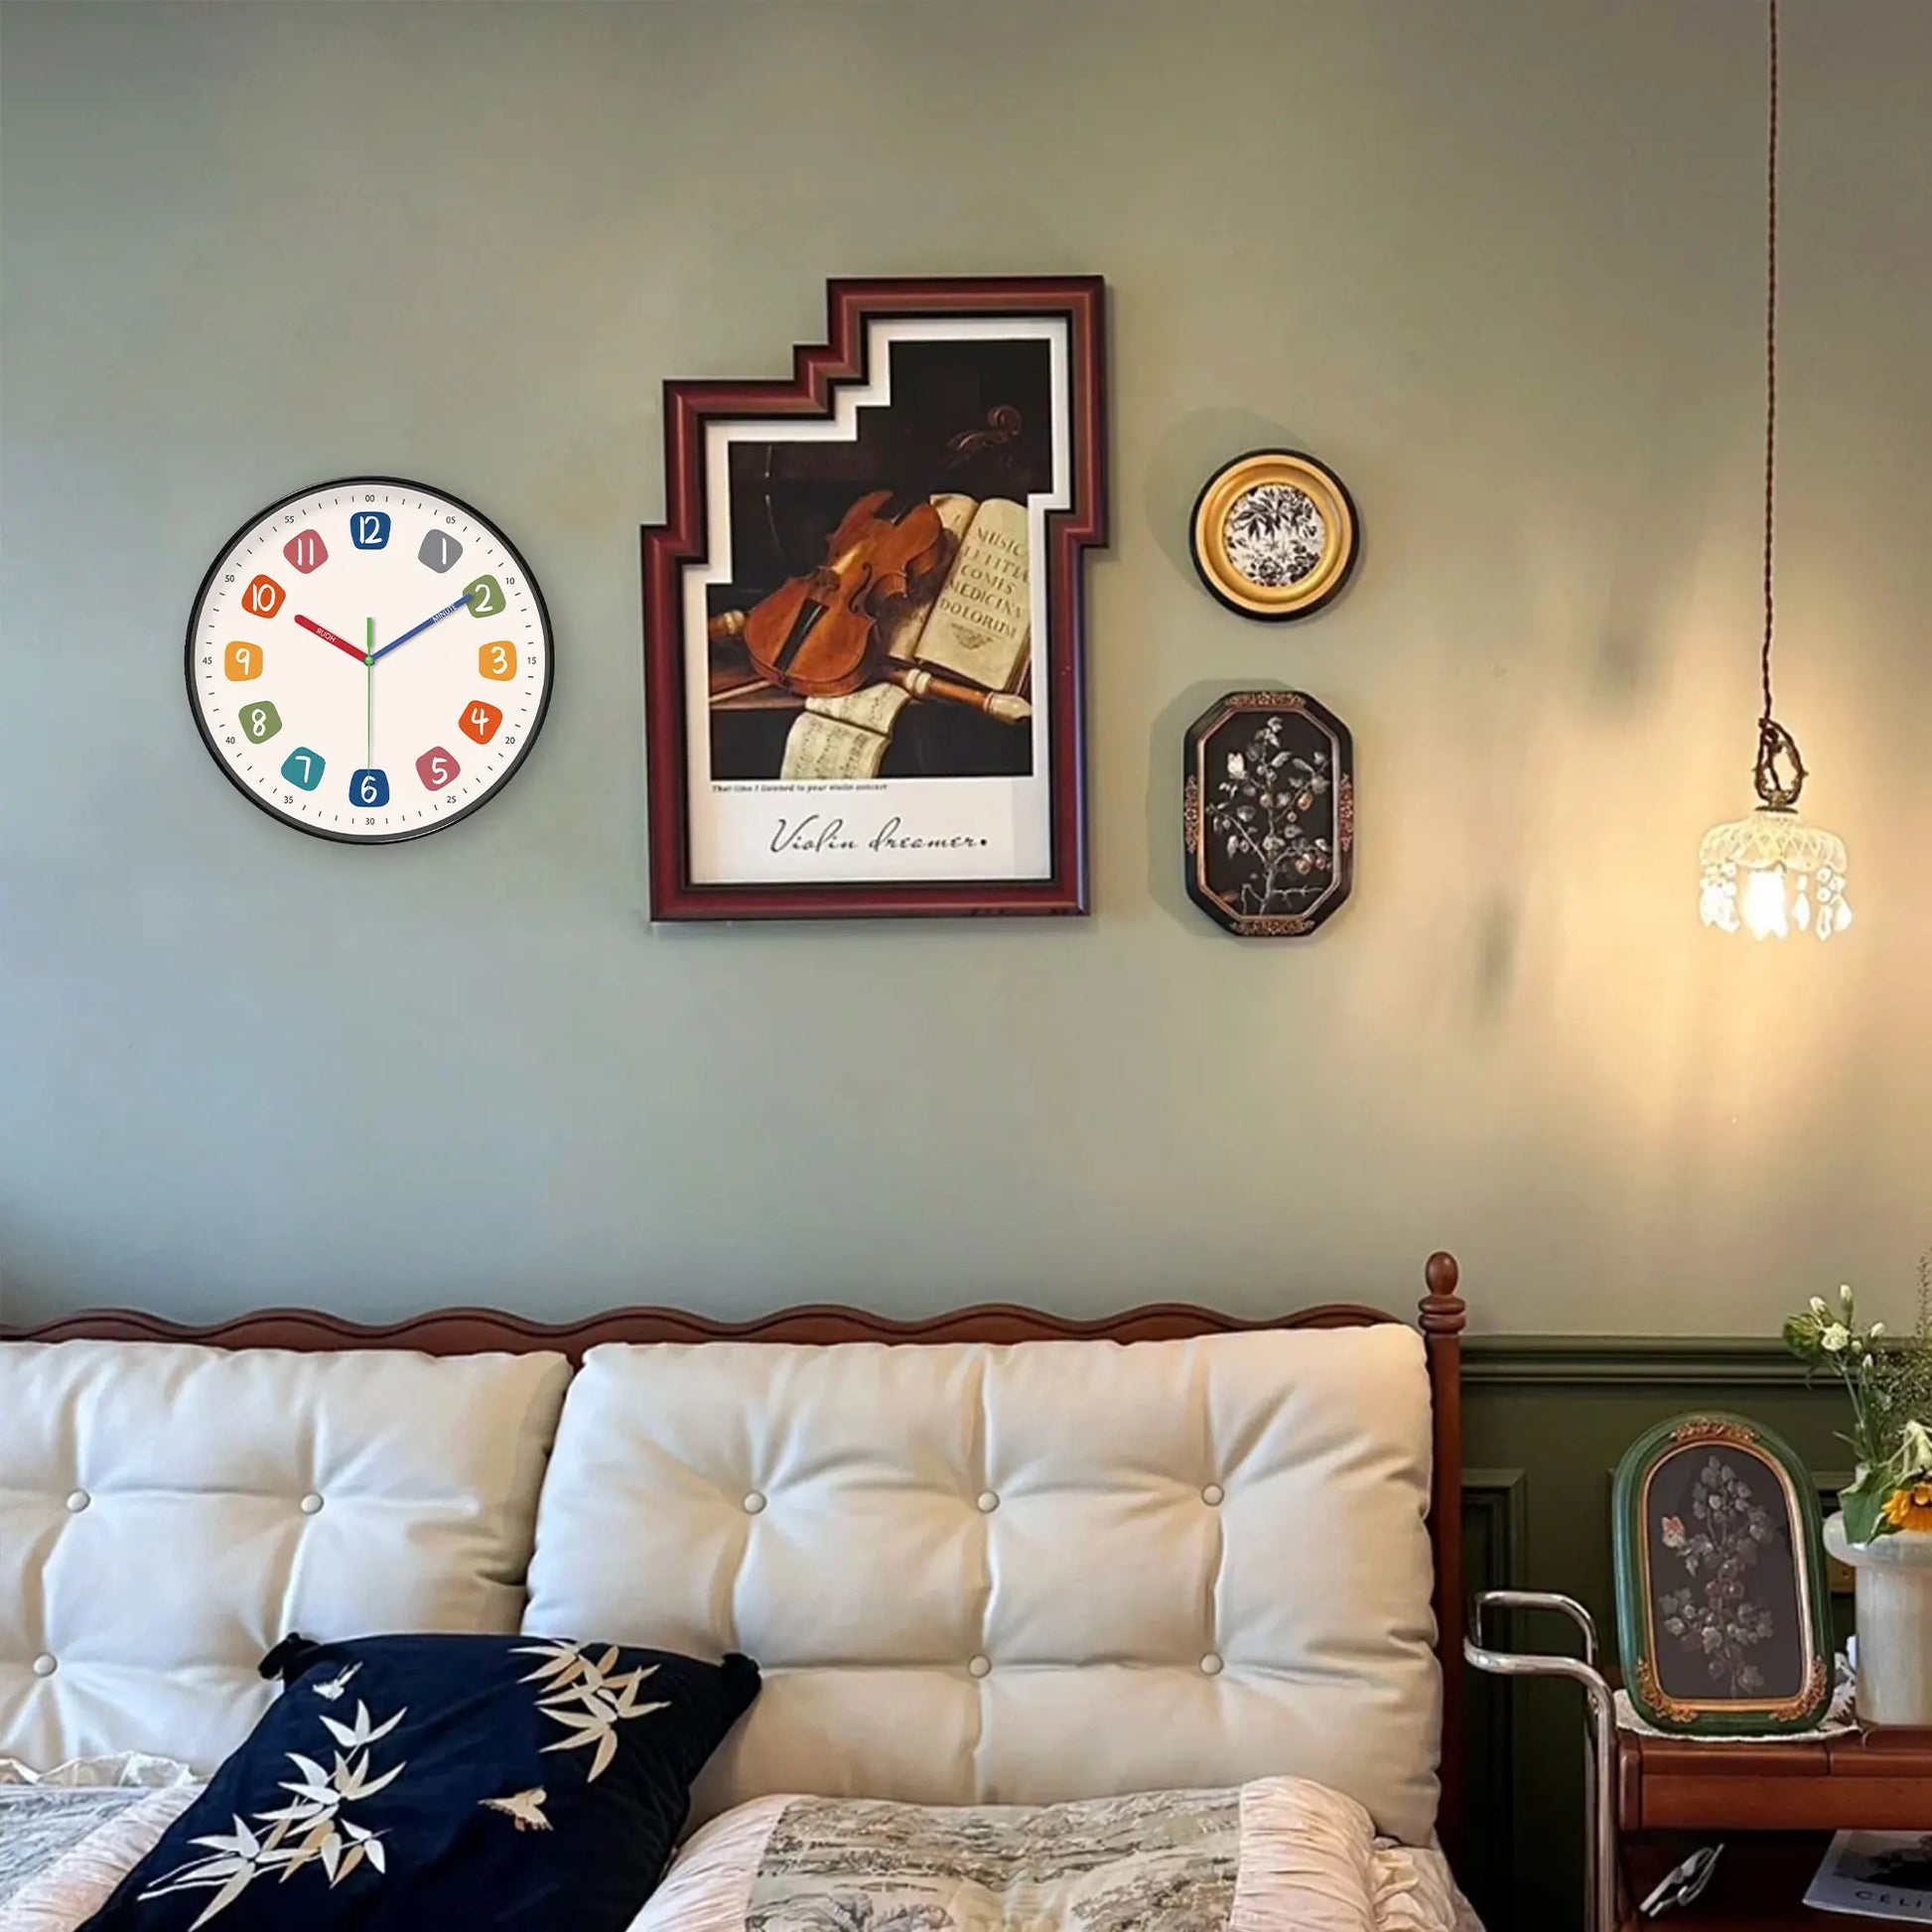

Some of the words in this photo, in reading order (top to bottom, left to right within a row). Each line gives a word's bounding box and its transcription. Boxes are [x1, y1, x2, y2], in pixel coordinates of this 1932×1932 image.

[364, 493, 375, 503] 00
[284, 515, 295, 525] 55
[359, 515, 382, 544] 12
[445, 515, 457, 525] 05
[297, 538, 314, 566] 11
[442, 536, 450, 565] 1
[224, 574, 235, 584] 50
[505, 576, 515, 586] 10
[252, 584, 277, 612] 10
[475, 584, 493, 613] 2
[432, 604, 457, 623] MINUTE
[202, 656, 212, 666] 45
[236, 647, 250, 675] 9
[491, 646, 508, 674] 3
[527, 656, 537, 666] 15
[251, 708, 267, 737] 8
[471, 708, 489, 736] 4
[224, 736, 236, 746] 40
[504, 736, 516, 746] 20
[295, 756, 311, 785] 7
[432, 757, 448, 785] 5
[361, 774, 377, 803] 6
[283, 795, 294, 805] 35
[446, 795, 457, 805] 25
[364, 817, 375, 827] 30
[770, 814, 858, 853] Violin
[1855, 1890, 1932, 1909] CELI
